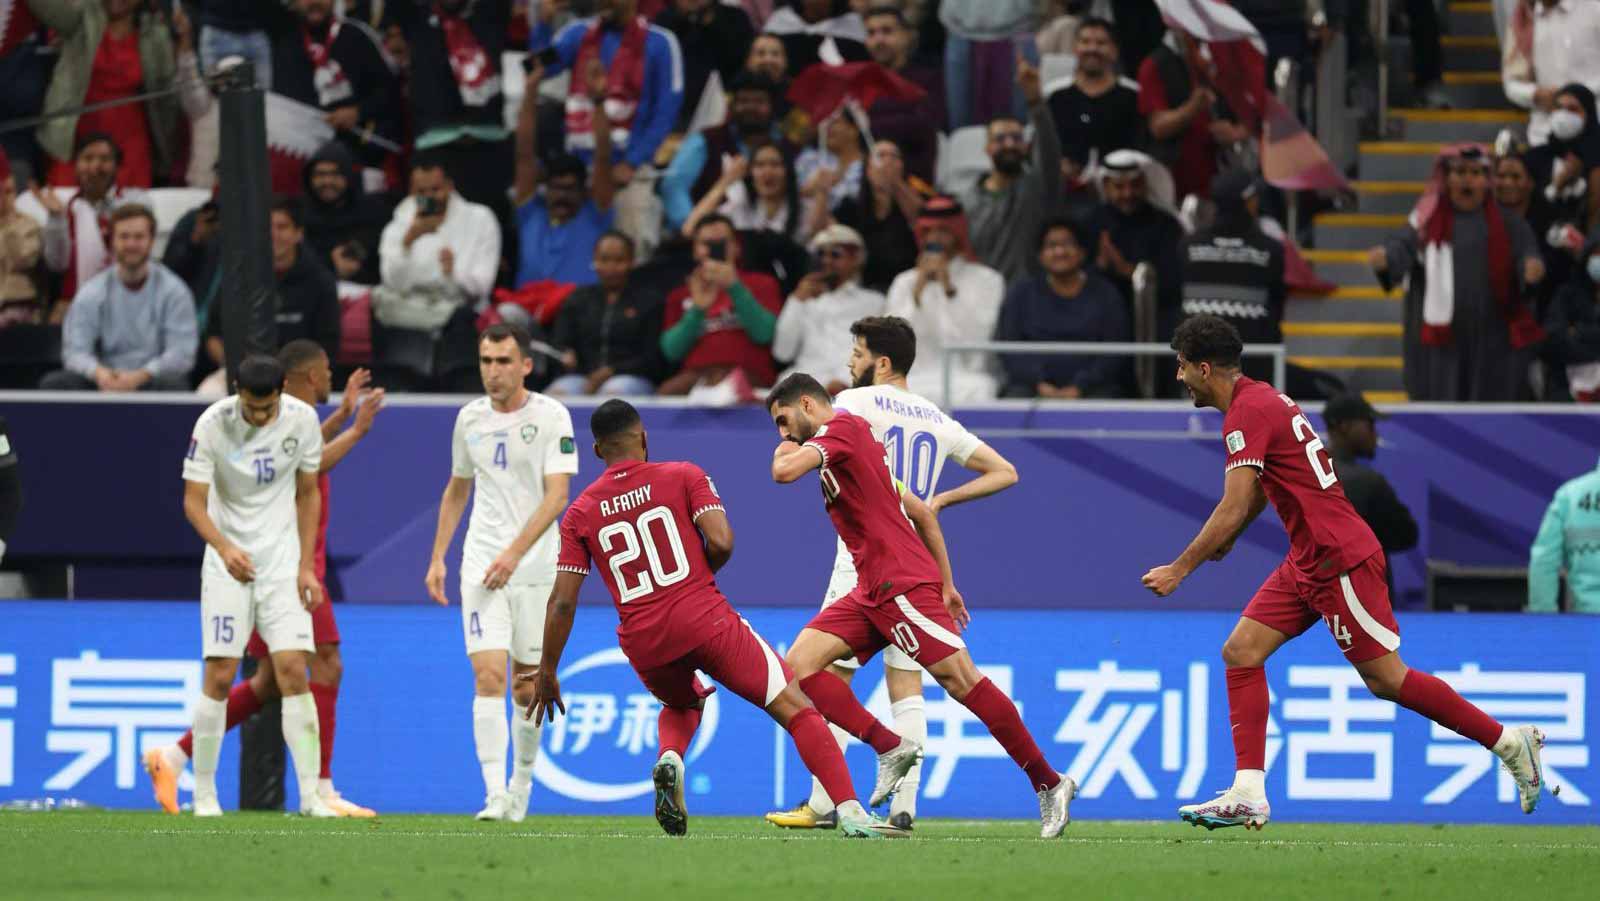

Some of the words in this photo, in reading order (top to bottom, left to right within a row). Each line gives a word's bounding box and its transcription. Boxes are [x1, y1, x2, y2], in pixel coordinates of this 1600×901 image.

[253, 458, 276, 485] 15
[493, 442, 507, 470] 4
[884, 424, 937, 501] 10
[600, 484, 651, 517] A.FATHY
[598, 505, 690, 604] 20
[213, 615, 235, 643] 15
[470, 611, 483, 637] 4
[891, 622, 919, 655] 10
[1322, 614, 1352, 645] 4
[0, 650, 203, 790] 泉
